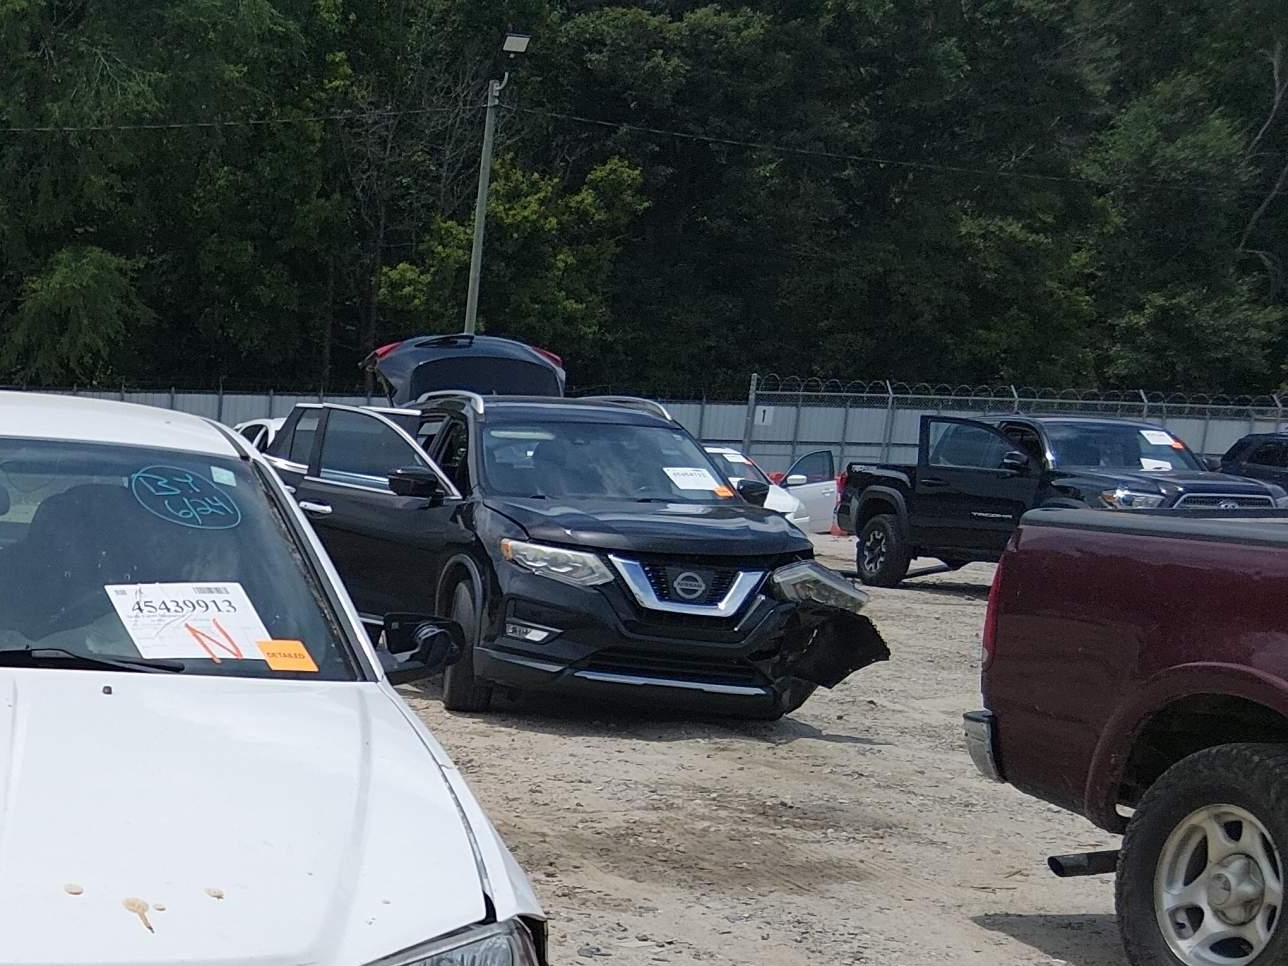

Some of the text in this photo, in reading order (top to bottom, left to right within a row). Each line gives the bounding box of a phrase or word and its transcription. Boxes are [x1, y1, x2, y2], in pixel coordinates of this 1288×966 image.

[164, 496, 233, 526] 6/24
[131, 599, 238, 614] 45439913
[184, 618, 244, 664] N
